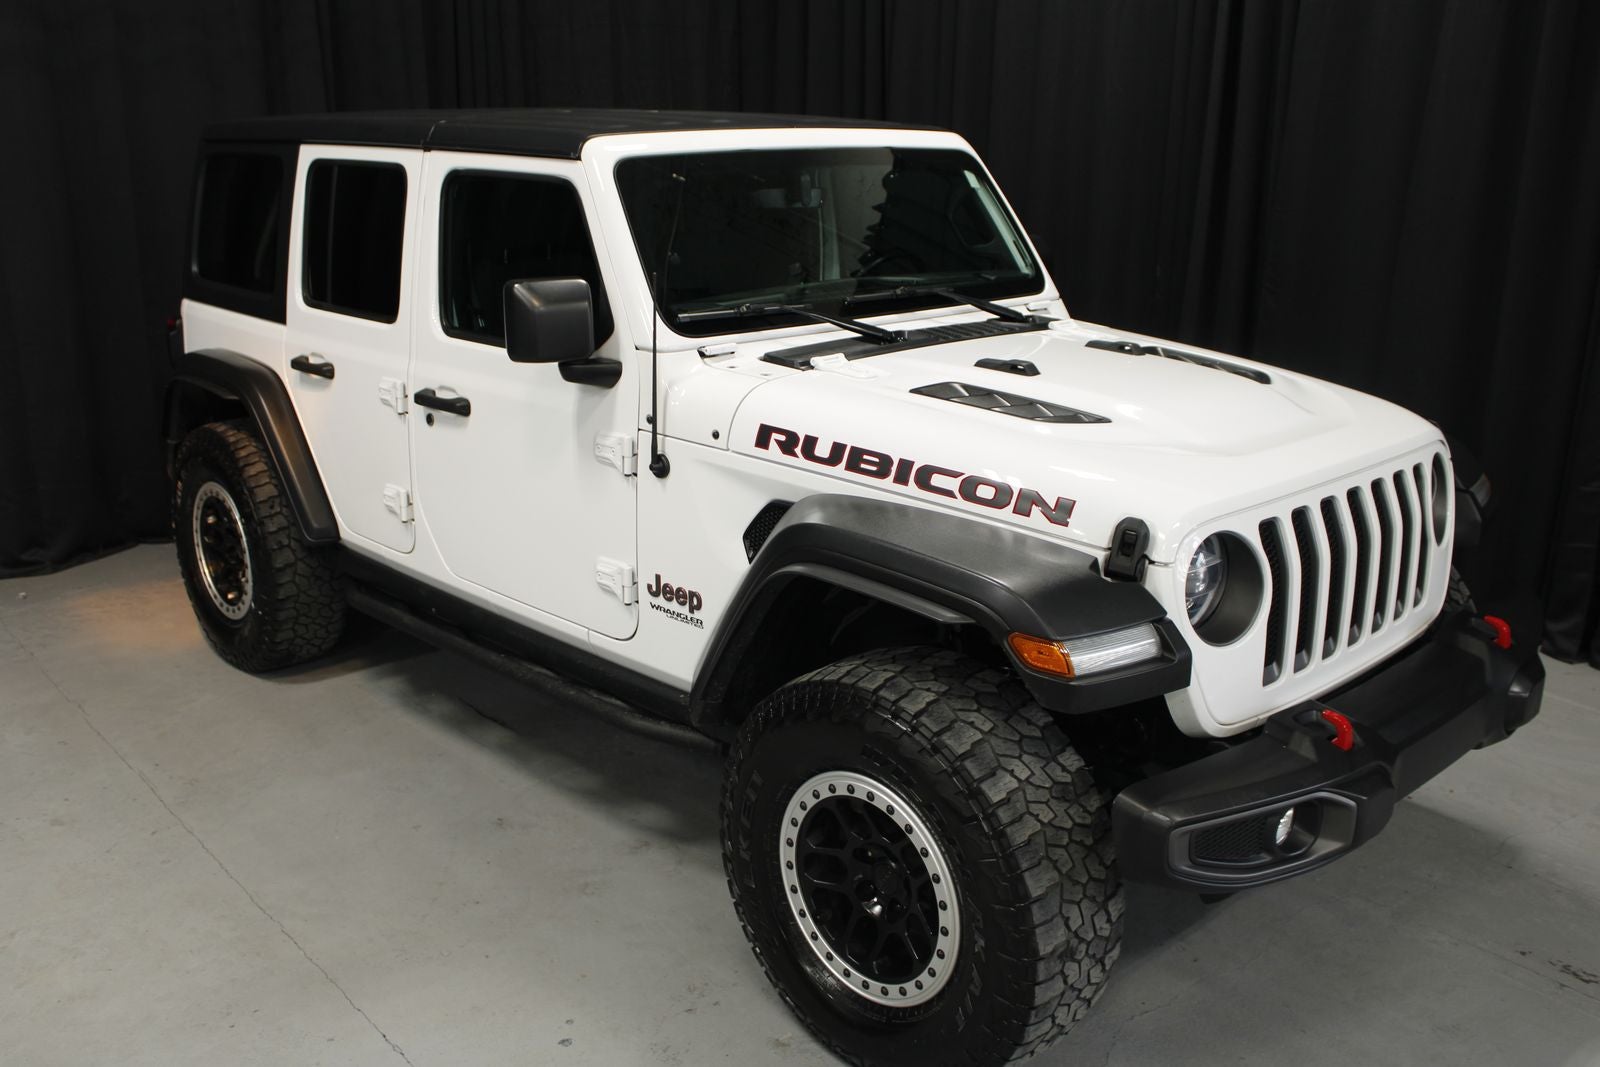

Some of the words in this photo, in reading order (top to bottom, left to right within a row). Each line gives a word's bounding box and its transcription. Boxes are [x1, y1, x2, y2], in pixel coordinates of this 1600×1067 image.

[754, 423, 1077, 527] RUBICON
[647, 573, 703, 614] Jeep
[649, 601, 704, 626] WRANGLER
